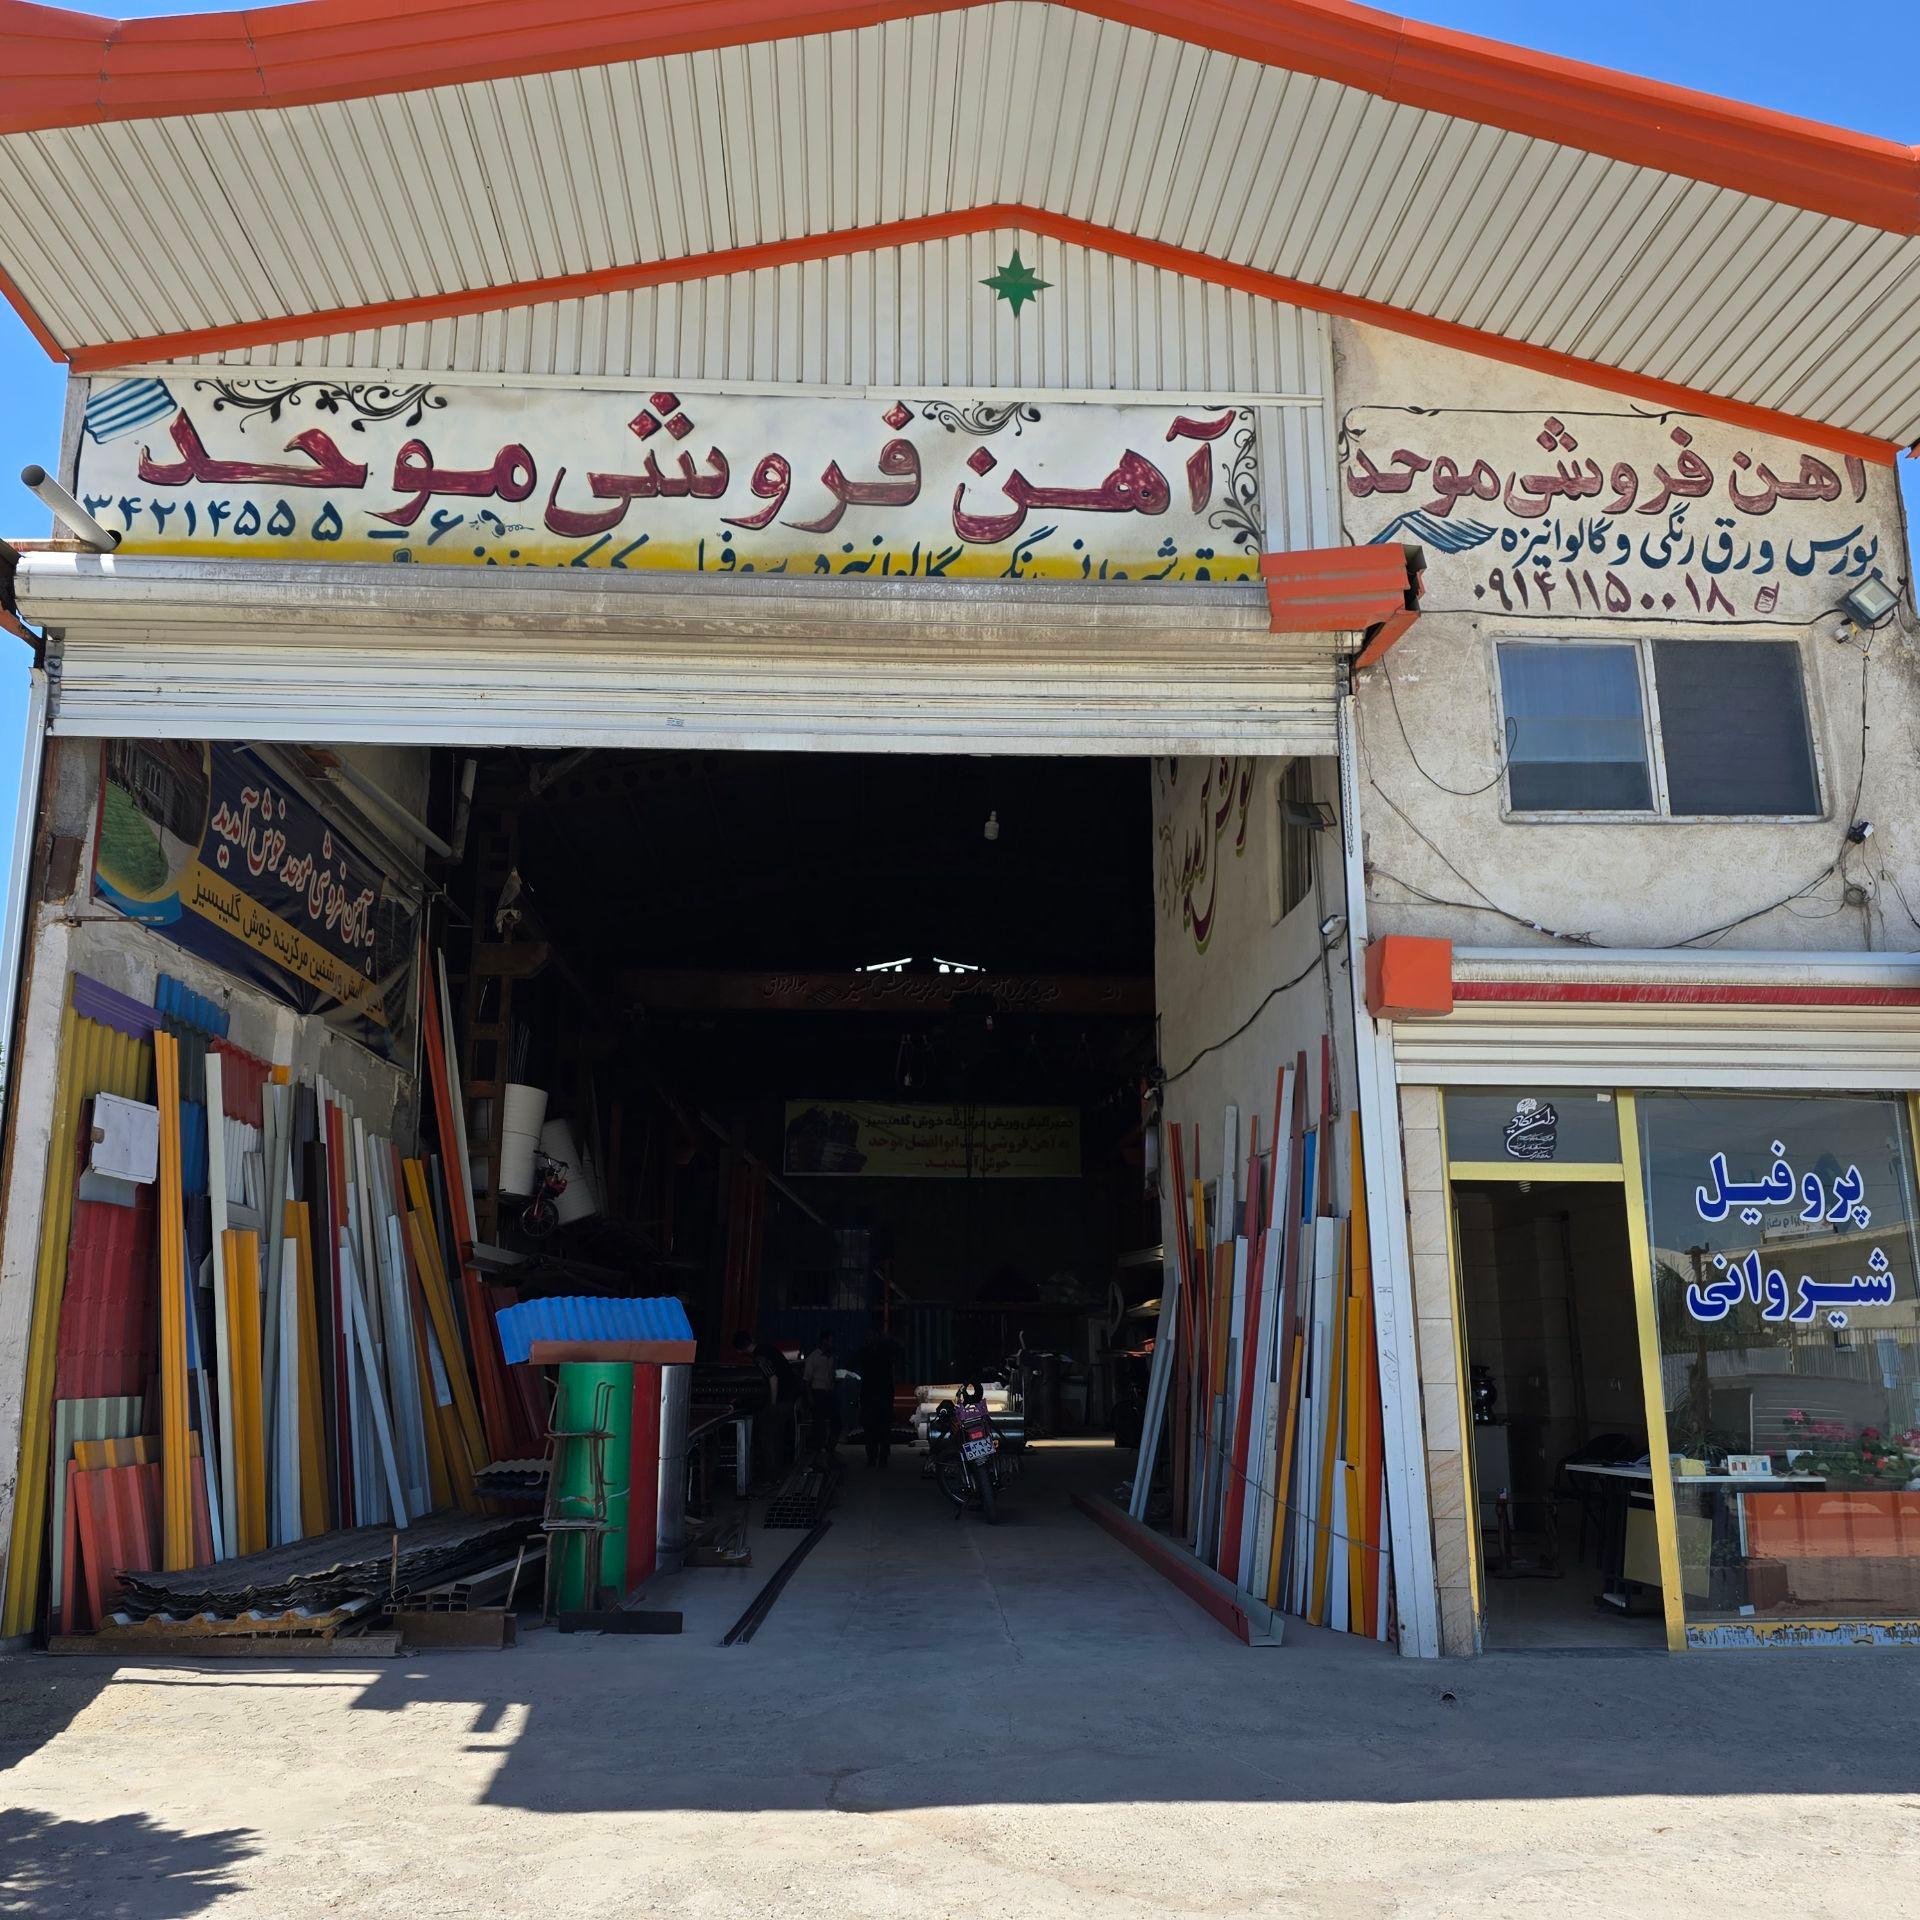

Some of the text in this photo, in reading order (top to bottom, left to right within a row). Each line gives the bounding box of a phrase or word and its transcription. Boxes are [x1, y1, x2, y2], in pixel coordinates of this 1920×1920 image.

[138, 391, 1235, 544] آهن فروشی موحد
[1346, 447, 1501, 517] موحد
[1504, 415, 1714, 518] فروشی
[1501, 501, 1883, 578] بورس ورق رنگی و گالوانیزه
[212, 786, 260, 868] آمدید
[247, 787, 286, 876] خوش
[280, 853, 313, 892] موحد
[308, 830, 347, 931] فروشی
[341, 888, 374, 948] آهن
[1696, 1139, 1871, 1229] پروفیل
[1686, 1247, 1896, 1328] شیروانی
